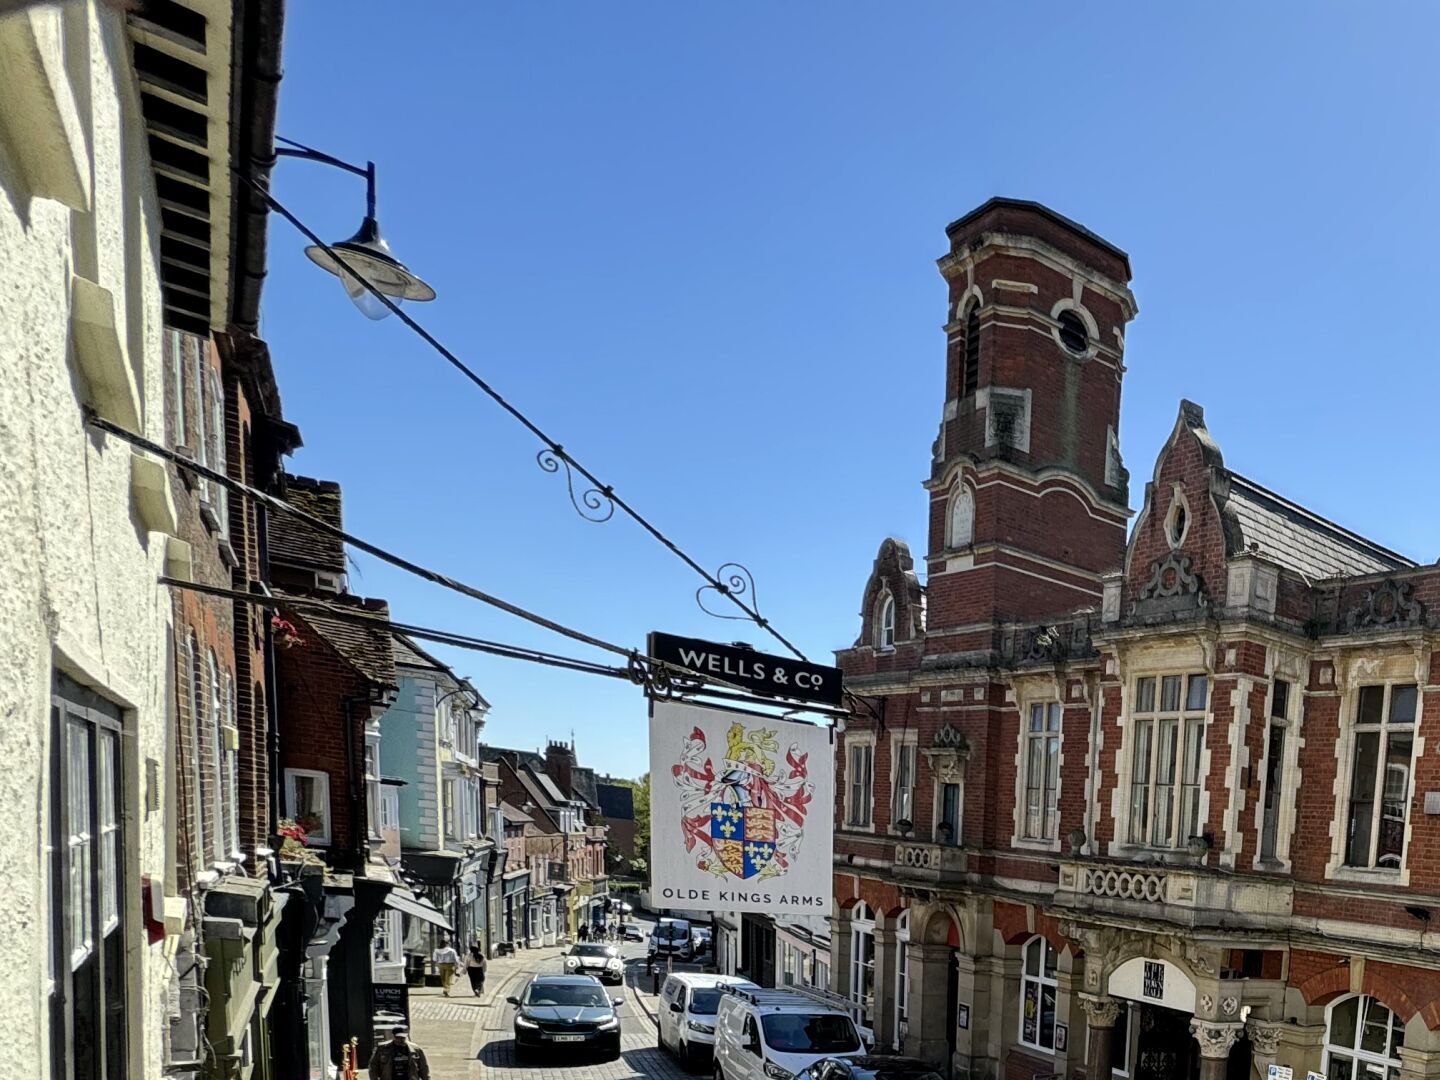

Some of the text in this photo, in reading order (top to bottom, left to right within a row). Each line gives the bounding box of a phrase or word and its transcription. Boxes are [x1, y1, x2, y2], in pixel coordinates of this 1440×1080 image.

[679, 648, 766, 681] WELLS
[772, 667, 789, 684] &
[662, 888, 824, 907] OLDE KINGS ARMS
